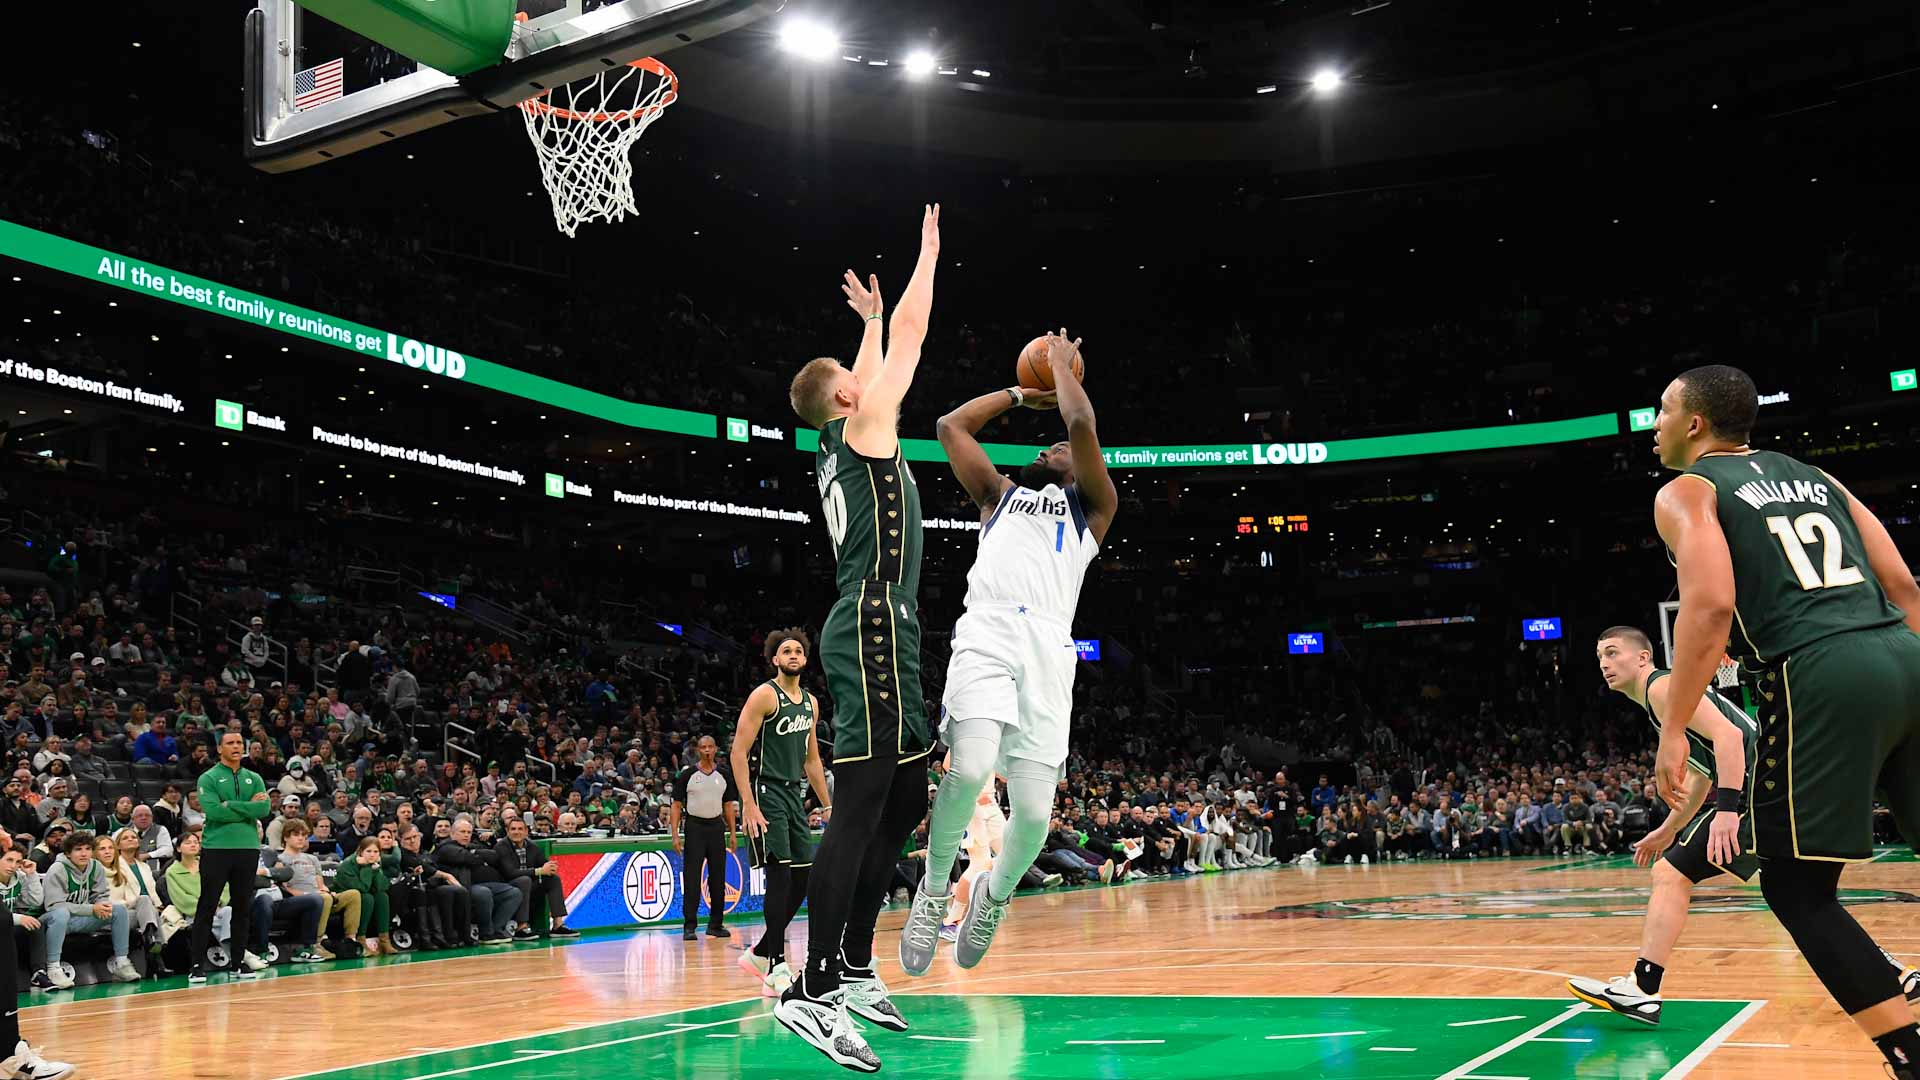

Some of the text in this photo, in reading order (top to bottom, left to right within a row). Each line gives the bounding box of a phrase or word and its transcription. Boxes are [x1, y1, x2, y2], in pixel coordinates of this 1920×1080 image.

[98, 257, 465, 378] All the best family reunions get LOUD
[15, 363, 44, 381] the
[47, 368, 104, 394] Boston
[106, 381, 132, 400] fan
[134, 388, 184, 412] family.
[1894, 372, 1915, 387] TD
[218, 404, 285, 431] TD Bank
[1632, 392, 1789, 427] TD Bank
[729, 421, 783, 440] TD Bank
[313, 427, 525, 485] Proud to be part of the Boston fan family.
[1115, 451, 1157, 464] family
[1162, 450, 1221, 462] reunions
[1225, 450, 1248, 463] get
[1253, 443, 1327, 464] LOUD
[566, 481, 592, 496] Bank
[1734, 479, 1828, 510] WILLIAMS
[614, 491, 810, 524] Proud to be part of the Boston fan family.
[1008, 496, 1066, 516] DALAS
[939, 519, 950, 528] to
[951, 519, 964, 529] be
[1056, 521, 1066, 552] 1
[1766, 512, 1865, 591] 12
[1529, 623, 1555, 632] ULTRA
[1293, 638, 1318, 646] ULTRA
